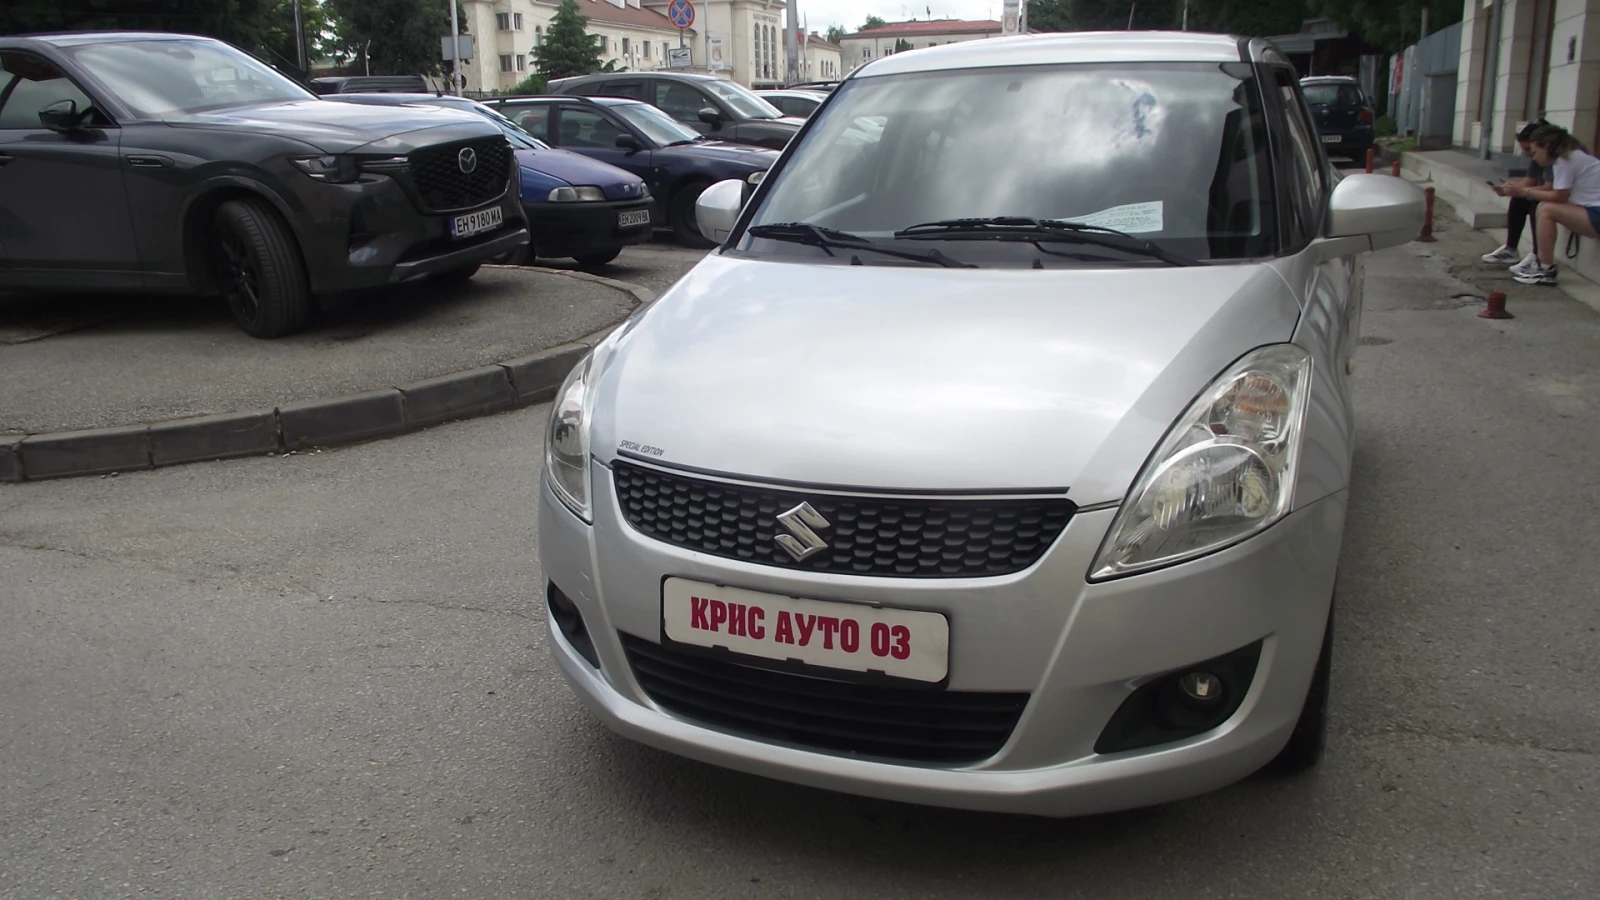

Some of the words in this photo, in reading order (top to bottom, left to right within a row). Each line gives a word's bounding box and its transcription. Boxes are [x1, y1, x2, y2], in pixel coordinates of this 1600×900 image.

[619, 440, 641, 451] SPECIAL
[641, 445, 665, 456] EDITION
[690, 596, 765, 640] КРИС
[774, 610, 860, 653] АУТО
